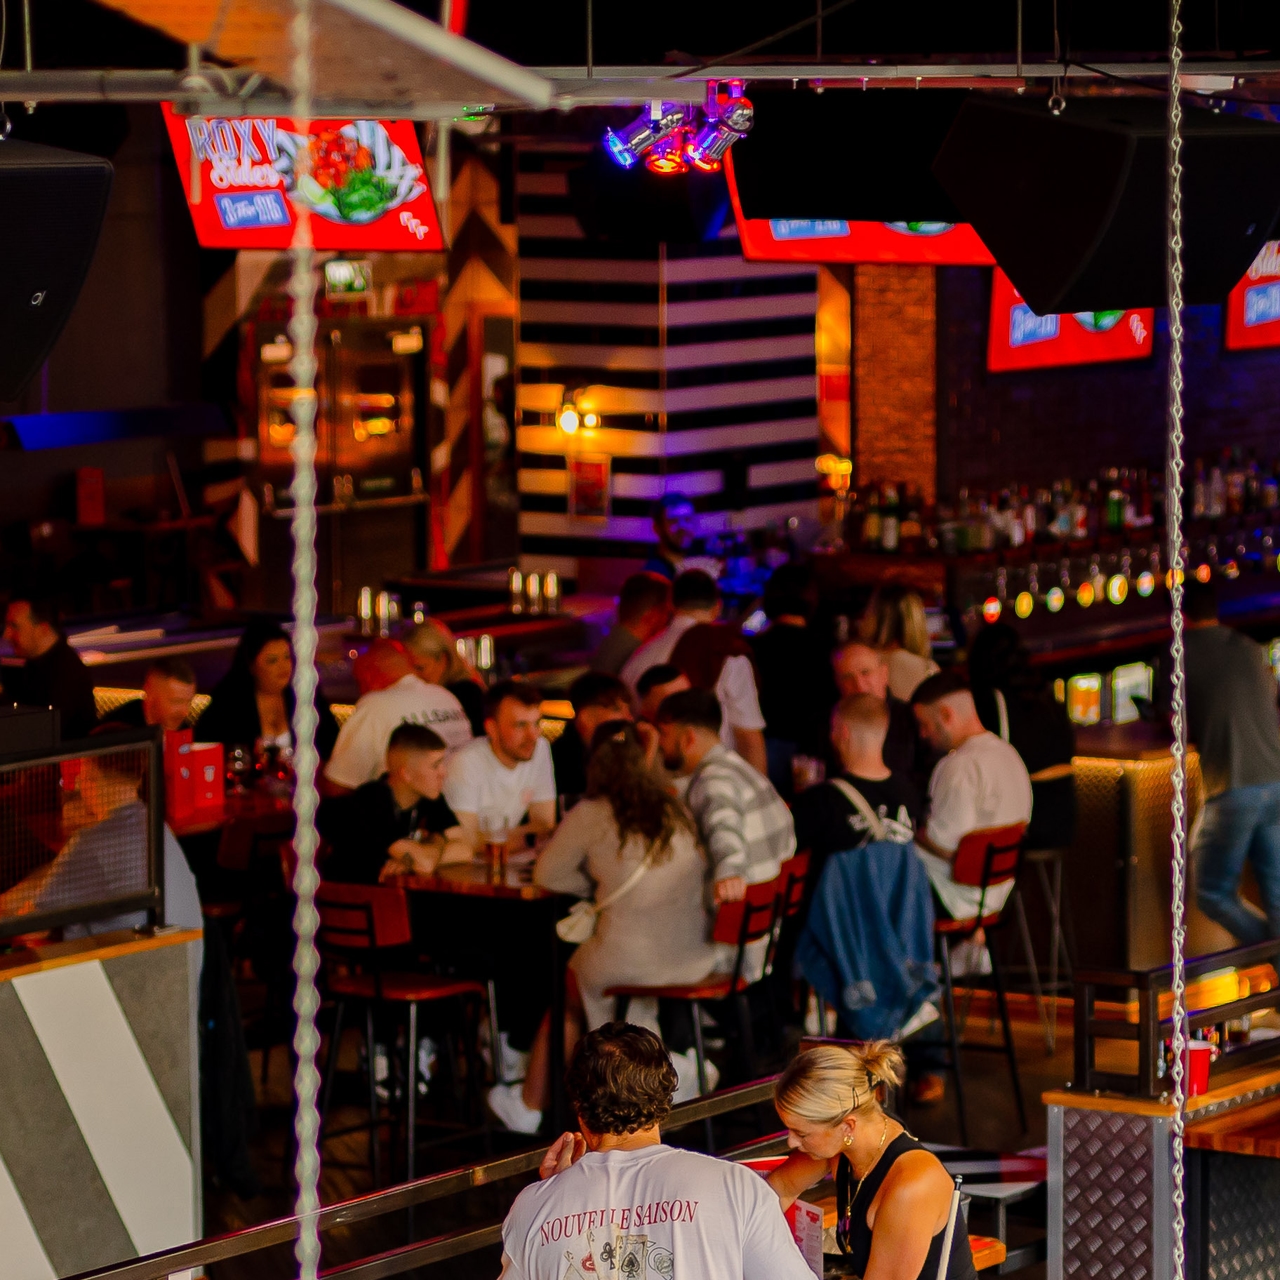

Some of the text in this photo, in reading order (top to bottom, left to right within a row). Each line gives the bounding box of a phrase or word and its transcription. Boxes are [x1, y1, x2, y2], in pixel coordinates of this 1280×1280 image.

[185, 119, 277, 161] ROXY
[540, 1199, 699, 1247] NOUVELLE SAISON
